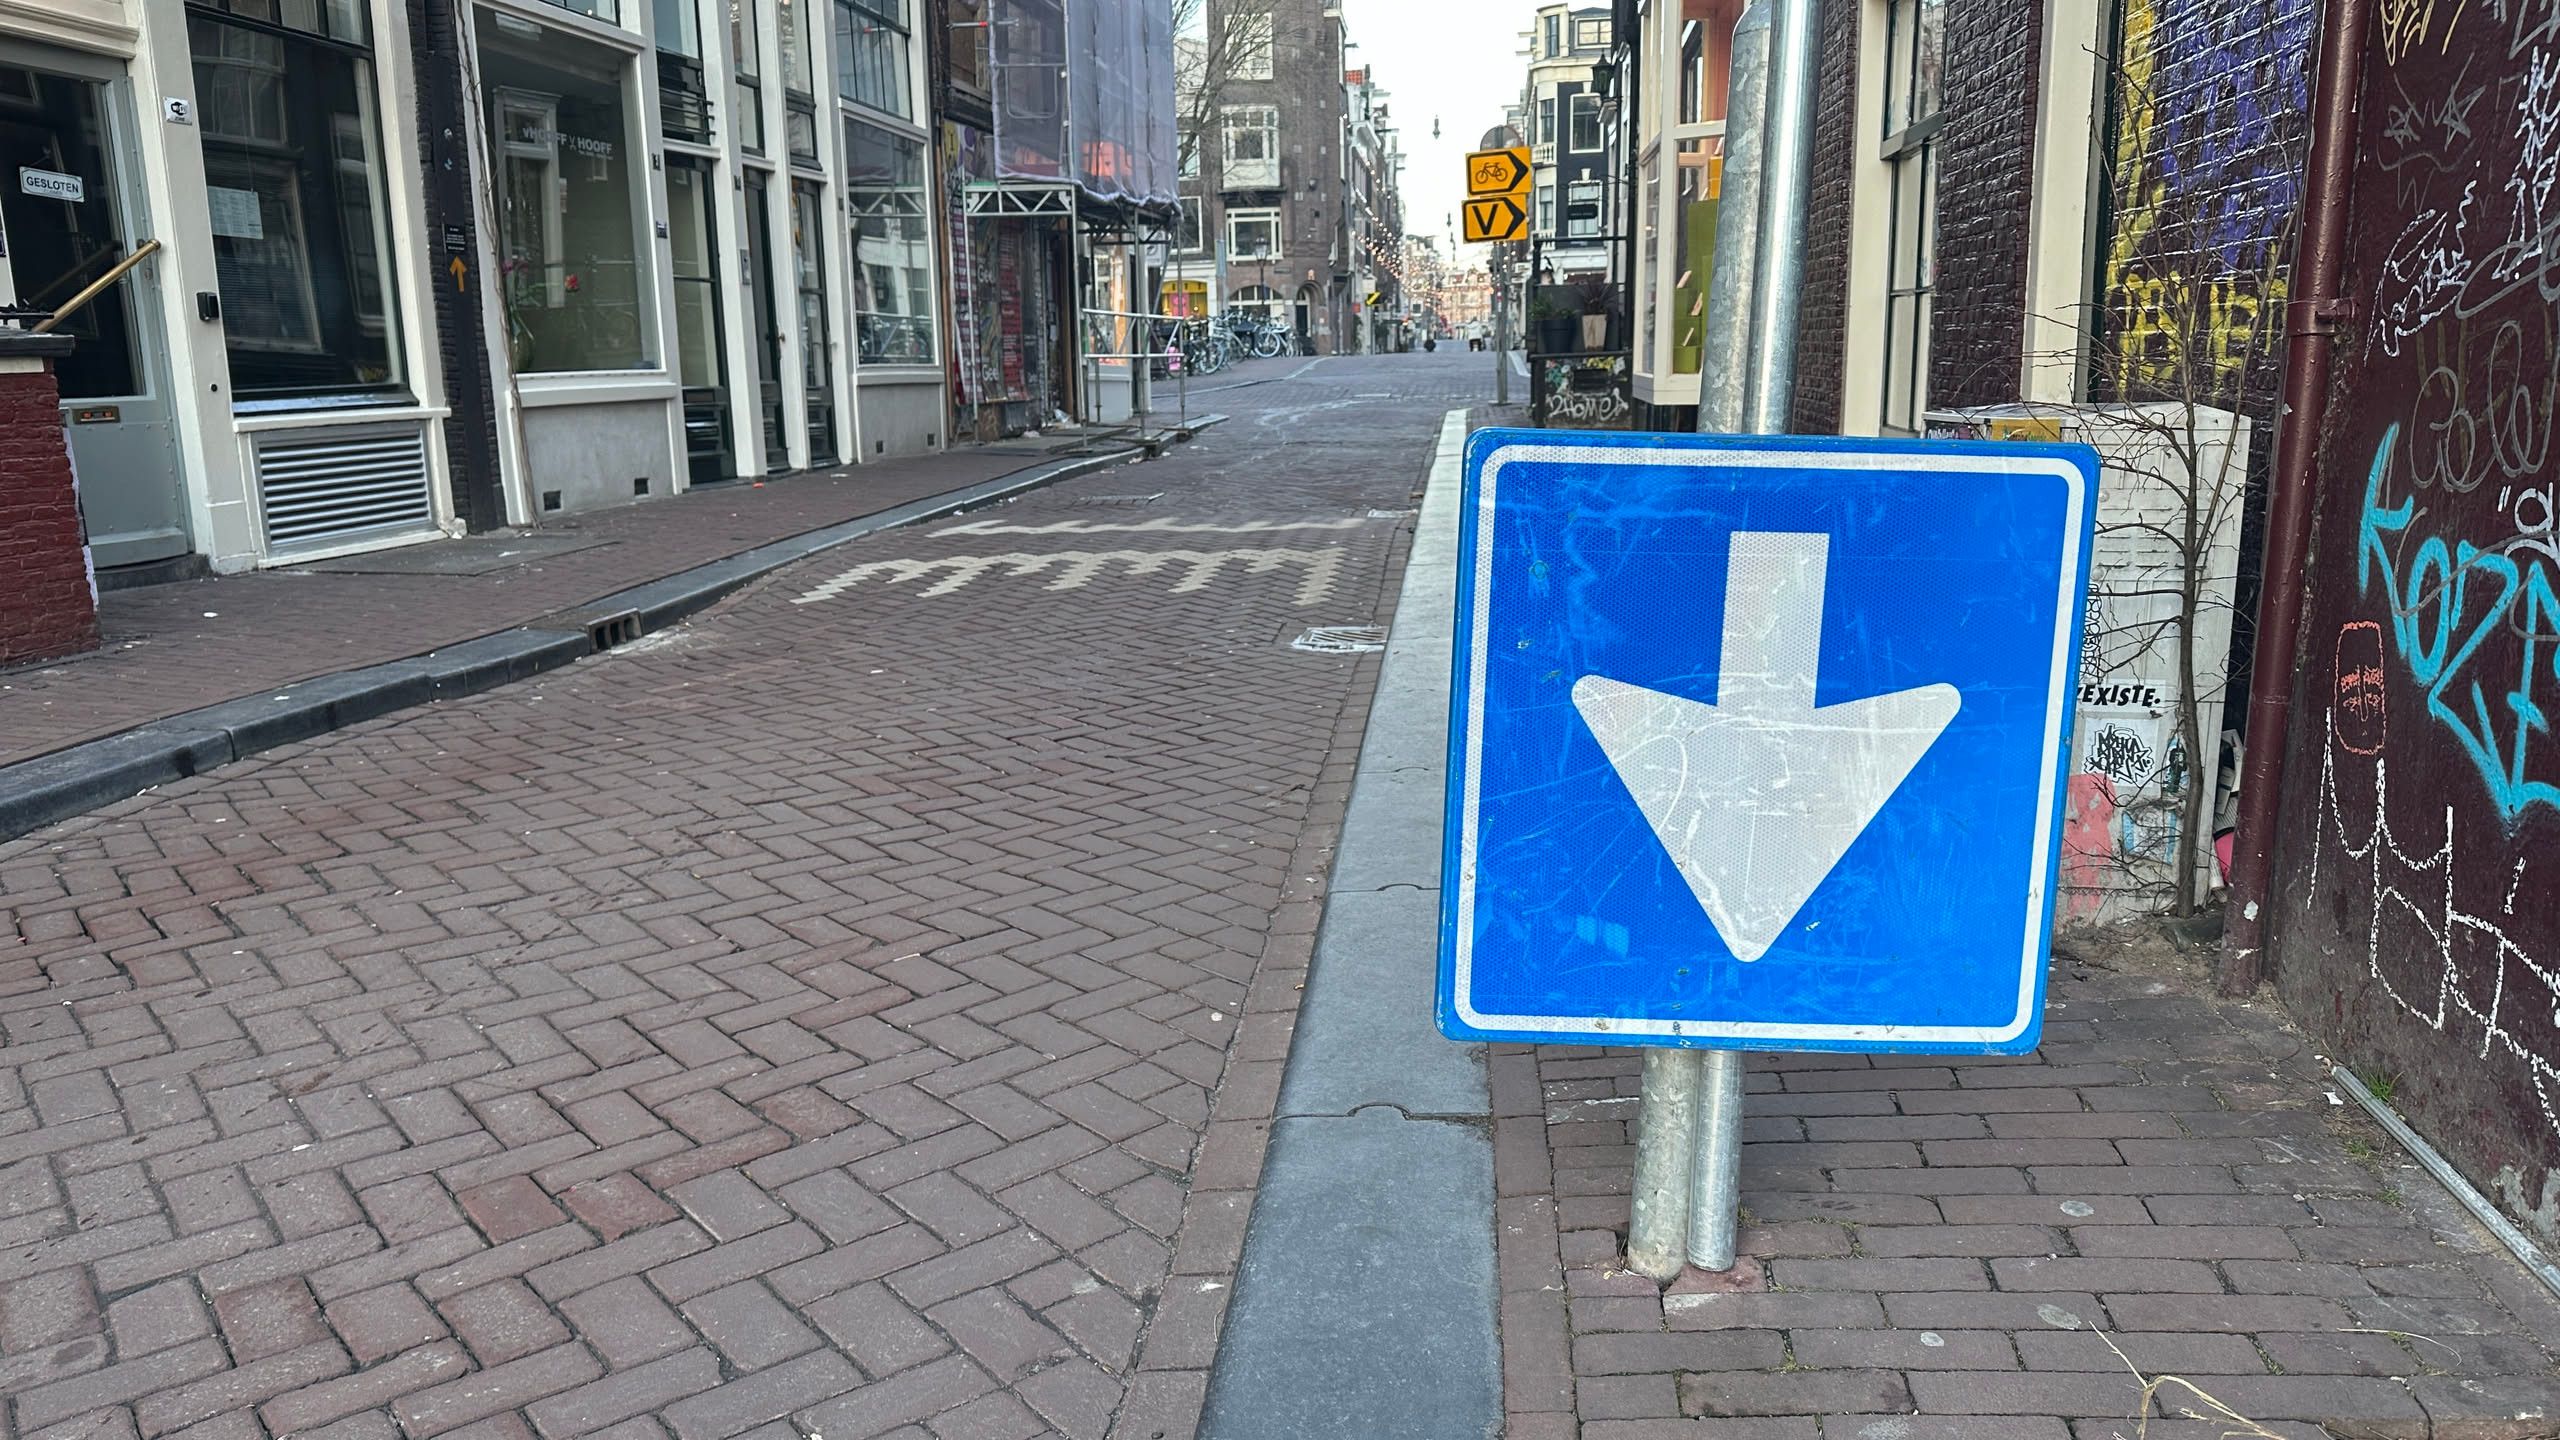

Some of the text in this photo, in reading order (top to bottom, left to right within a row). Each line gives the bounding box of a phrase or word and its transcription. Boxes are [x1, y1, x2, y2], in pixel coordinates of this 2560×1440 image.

[577, 136, 612, 154] HOOFF
[26, 176, 79, 193] GESLOTEN
[1472, 203, 1499, 236] V
